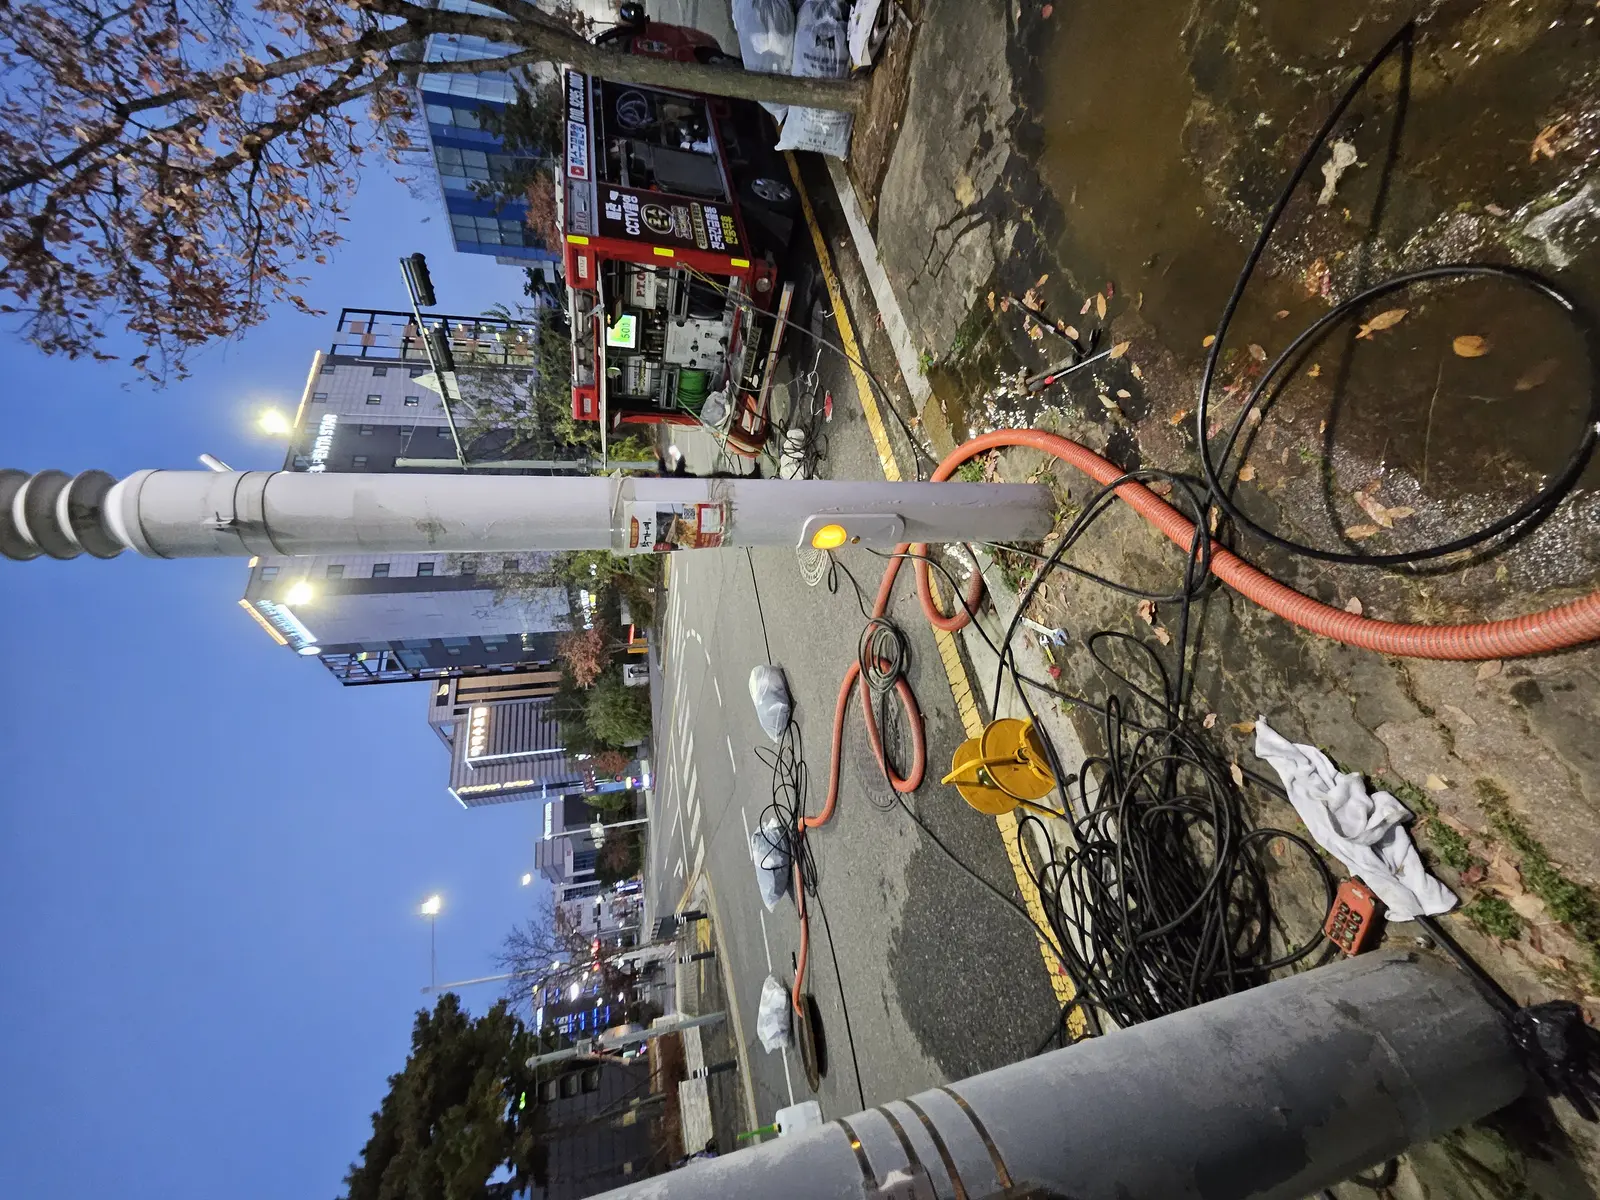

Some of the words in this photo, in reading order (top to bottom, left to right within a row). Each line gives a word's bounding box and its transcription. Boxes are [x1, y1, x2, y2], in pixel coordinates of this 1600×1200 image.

[605, 202, 622, 220] 배관
[622, 194, 640, 235] CCTV촬영
[704, 206, 725, 250] 전국긴급출동
[720, 214, 738, 244] 연중무휴
[318, 414, 338, 436] STAR
[311, 436, 333, 464] PENTA
